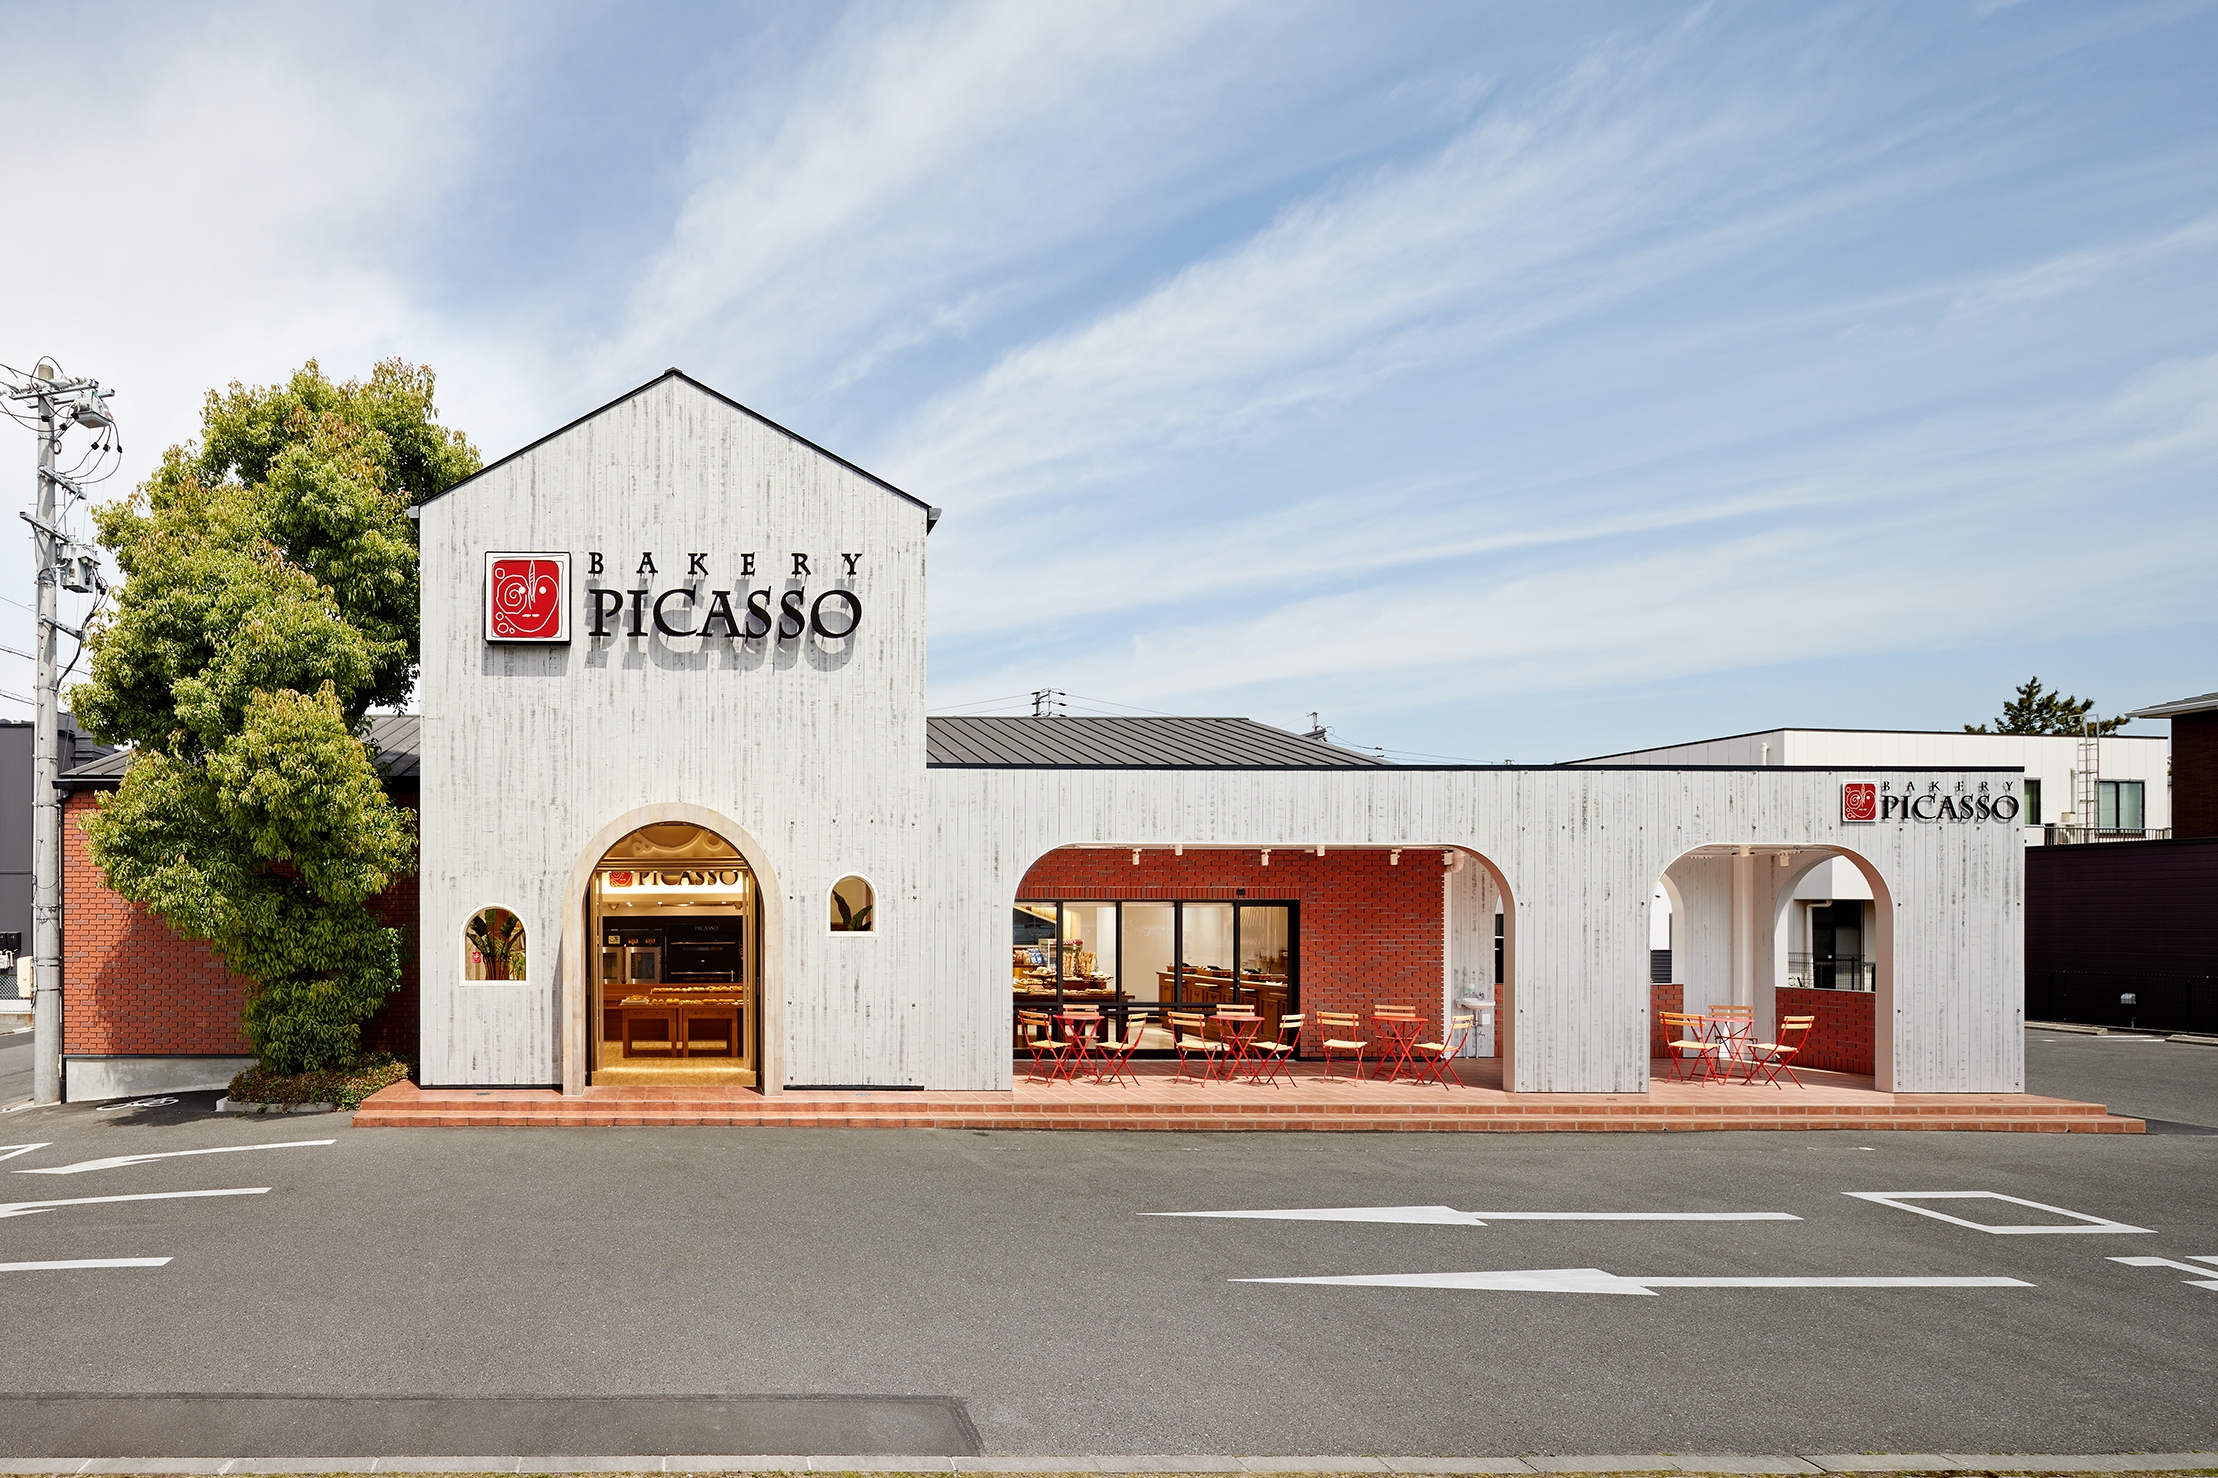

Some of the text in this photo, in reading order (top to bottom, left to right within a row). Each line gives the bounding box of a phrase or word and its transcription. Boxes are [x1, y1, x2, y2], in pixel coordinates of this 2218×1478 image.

[588, 551, 862, 576] BAKERY
[588, 585, 863, 645] PICASSO
[1882, 781, 2014, 792] BAKERY
[1881, 793, 2020, 822] PICASSO
